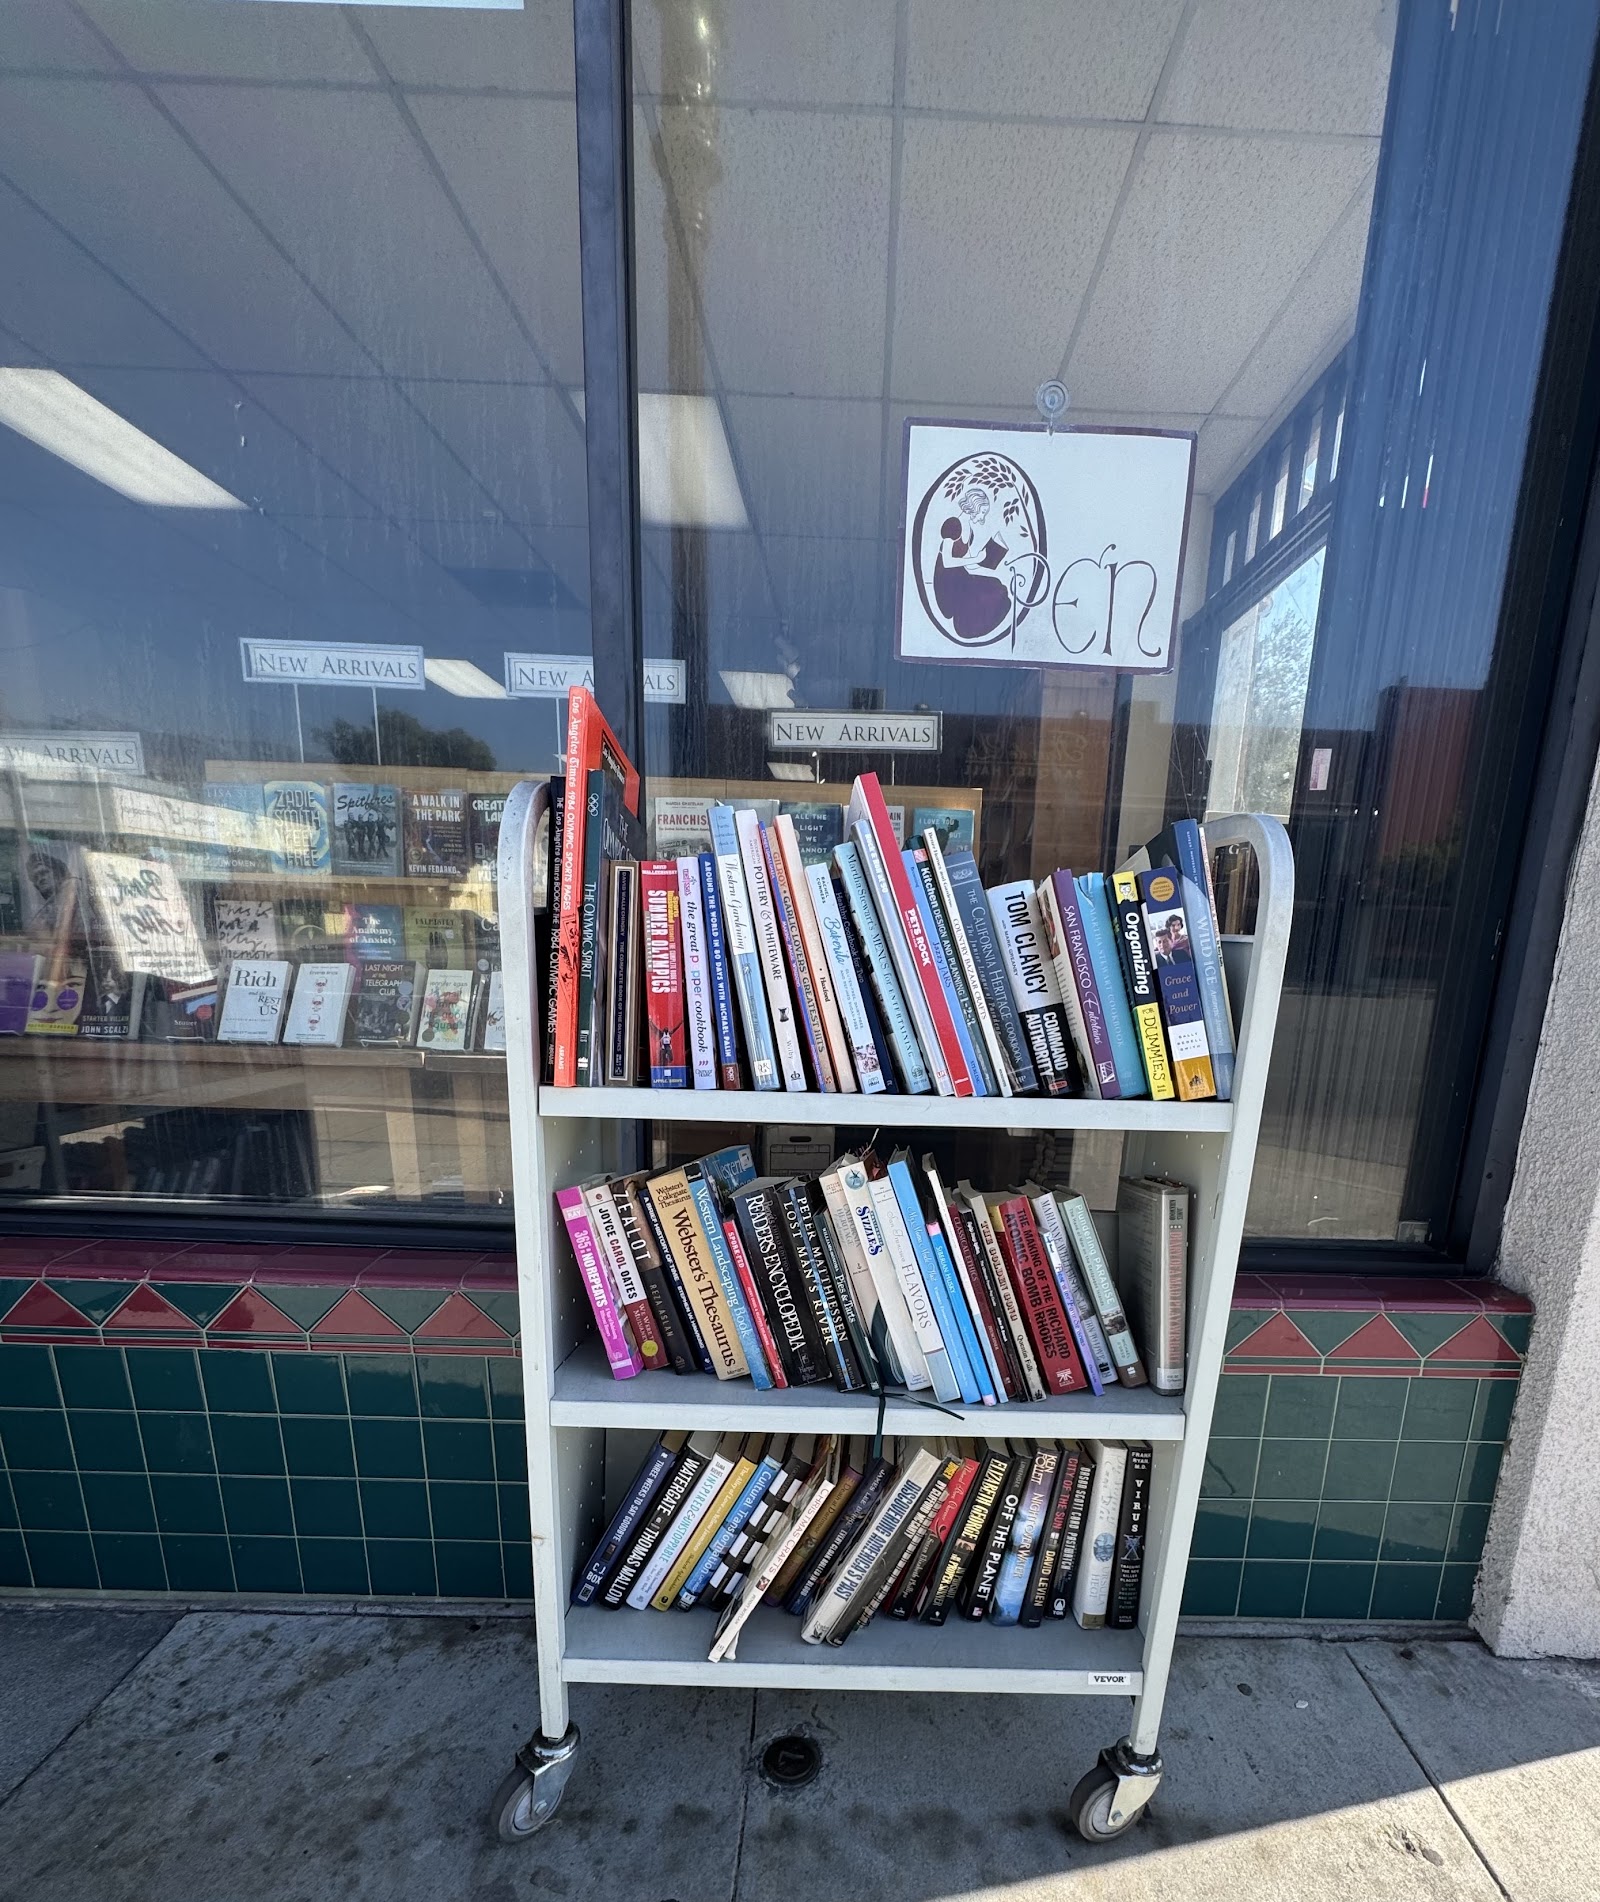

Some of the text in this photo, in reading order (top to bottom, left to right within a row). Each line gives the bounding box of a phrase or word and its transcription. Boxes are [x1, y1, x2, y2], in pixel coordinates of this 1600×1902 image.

[259, 653, 417, 679] NEW ARRIVALS
[519, 668, 568, 686] NEW
[572, 696, 582, 713] Los
[43, 745, 135, 764] ARRIVALS
[569, 717, 581, 755] Angeles
[776, 723, 930, 743] NEW ARRIVALS
[569, 757, 579, 787] Times
[274, 790, 316, 808] ZADIE
[274, 809, 321, 829] SMITH
[337, 793, 393, 812] Spitfires
[413, 795, 460, 808] A WALK IN
[416, 809, 461, 822] THE PARK
[657, 815, 709, 825] FRANCHIS
[565, 813, 575, 849] OLYMPIC
[408, 864, 427, 873] KEVIN
[565, 852, 573, 883] SPORTS
[362, 917, 380, 926] The
[563, 885, 571, 910] PAGES
[349, 936, 397, 945] of Anxiety
[352, 926, 393, 935] Anatomy
[581, 882, 596, 979] THE OLYMPIC SPIRIT
[648, 890, 670, 993] SUMMER OLYMPICS
[705, 861, 713, 892] AROUND
[714, 950, 721, 959] 80
[720, 1003, 729, 1035] MICHAEL
[754, 866, 769, 907] POTTERY
[763, 922, 783, 980] WHITEWARE
[908, 908, 921, 935] PETS
[916, 936, 931, 967] ROCK
[921, 867, 975, 1026] Kitchen DESIGN AND PLANNING 1-2-3
[1005, 891, 1048, 995] TOM CLANCY
[1197, 916, 1213, 958] WILD
[365, 964, 381, 972] LAST
[687, 902, 707, 1052] the great pepper cookbook
[773, 852, 824, 1052] GILROY GARLIC GREATEST HITS
[847, 854, 914, 1058] Martha Stewart's MENUS for ENTERTAINING
[968, 889, 1022, 1064] THE CALIFORNIA HERITAGE COOKBOOK
[1064, 905, 1102, 1045] SAN FRANCISCO Entertains
[1126, 913, 1150, 995] Organizing
[1204, 964, 1217, 985] ICE
[235, 970, 277, 987] Rich
[366, 979, 402, 987] TELEGRAPH
[964, 958, 987, 1020] BAZAAR CRAFTS
[1165, 975, 1192, 986] Grace
[1172, 988, 1189, 999] and
[260, 1006, 278, 1015] US
[1169, 1003, 1198, 1014] Power
[1026, 1014, 1054, 1077] AUTHORITY
[1042, 1011, 1068, 1072] COMMAND
[1144, 1017, 1165, 1081] DUMMIES
[656, 1182, 684, 1194] Webster's
[657, 1189, 688, 1202] Collegiate
[659, 1195, 692, 1208] Thesaurus
[613, 1190, 651, 1260] ZEALOT
[797, 1197, 816, 1241] PETER
[856, 1206, 882, 1256] SIZZLES
[599, 1208, 638, 1299] JOYCE CAROL OATES
[696, 1187, 754, 1338] Western Landscaping Book
[784, 1201, 833, 1345] LOST RIVER
[1005, 1213, 1043, 1307] ATOMIC BOMB
[1017, 1208, 1054, 1305] THE MAKING OF THE
[1076, 1204, 1116, 1304] Plundering PARADISE
[650, 1284, 674, 1337] REZA ASLAN
[673, 1207, 736, 1367] Webster's Thesaurus
[763, 1252, 807, 1352] ENCYCLOPEDIA
[812, 1246, 848, 1341] MATTHIESSEN
[902, 1264, 932, 1329] FLAVORS
[1034, 1311, 1057, 1359] RHODES
[1046, 1307, 1070, 1359] RICHARD
[657, 1457, 700, 1516] WATERGATE
[1046, 1454, 1057, 1474] KEN
[961, 1457, 1008, 1541] ELIZABETH GEORGE
[1052, 1457, 1079, 1530] CITY SUN
[1131, 1479, 1144, 1532] VIRUS
[626, 1526, 660, 1568] THOMAS
[700, 1471, 772, 1575] Cultural Transformation
[768, 1488, 829, 1574] CHRISTMAS CRAFTS
[976, 1495, 1018, 1601] OFF THE PLANET
[586, 1573, 602, 1585] BOX
[604, 1565, 636, 1604] MALLON
[1033, 1550, 1056, 1607] DAVID LEVIEN
